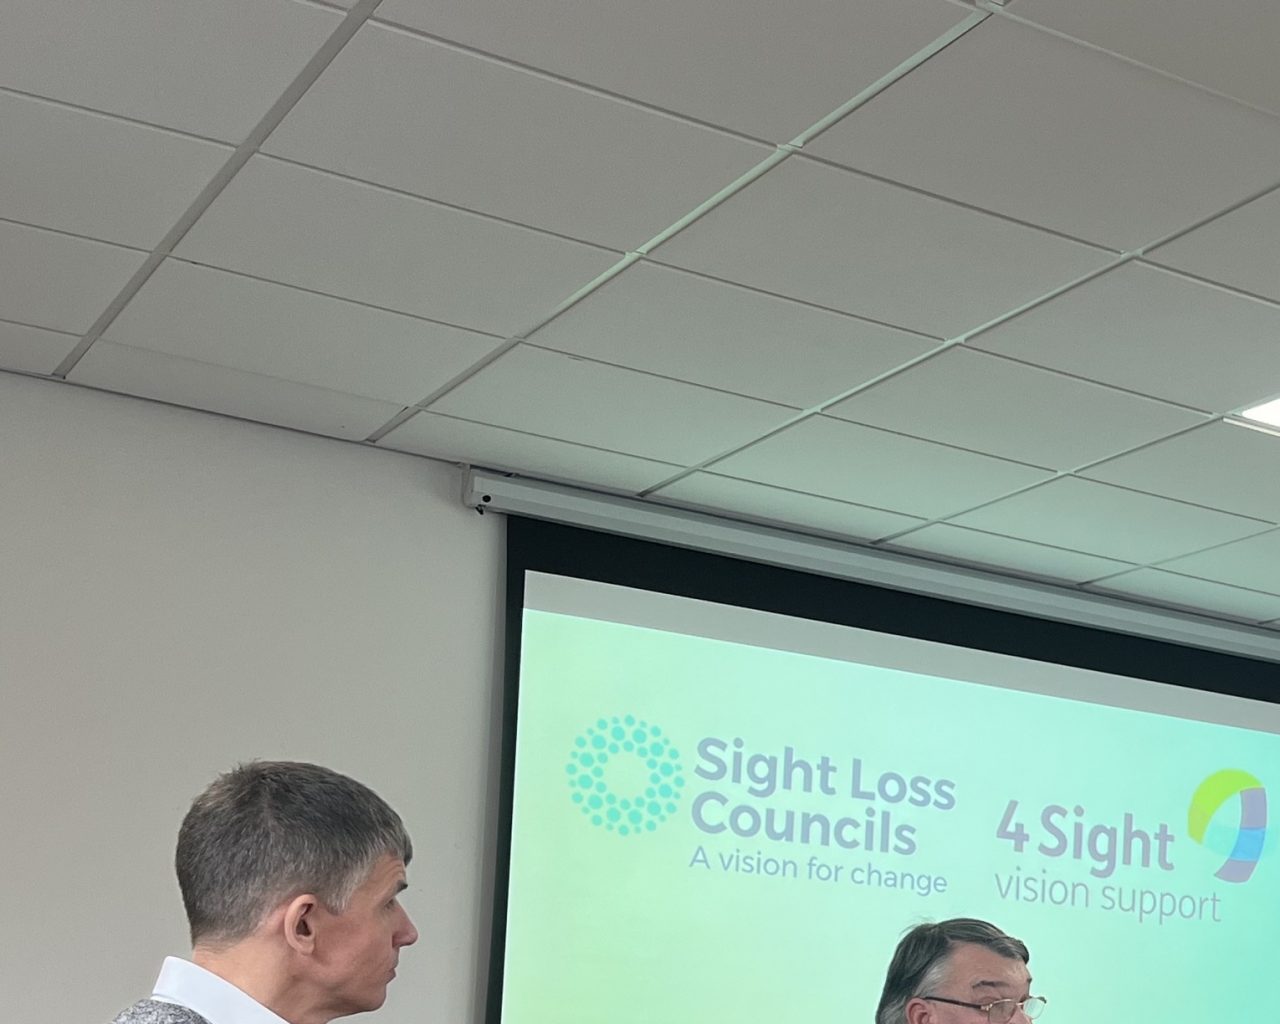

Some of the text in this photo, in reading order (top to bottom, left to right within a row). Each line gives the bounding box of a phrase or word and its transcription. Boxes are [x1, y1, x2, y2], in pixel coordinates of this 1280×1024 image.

[694, 737, 956, 811] Sight Loss
[691, 791, 917, 856] Councils
[689, 845, 948, 897] A vision for change
[995, 866, 1221, 925] vision support
